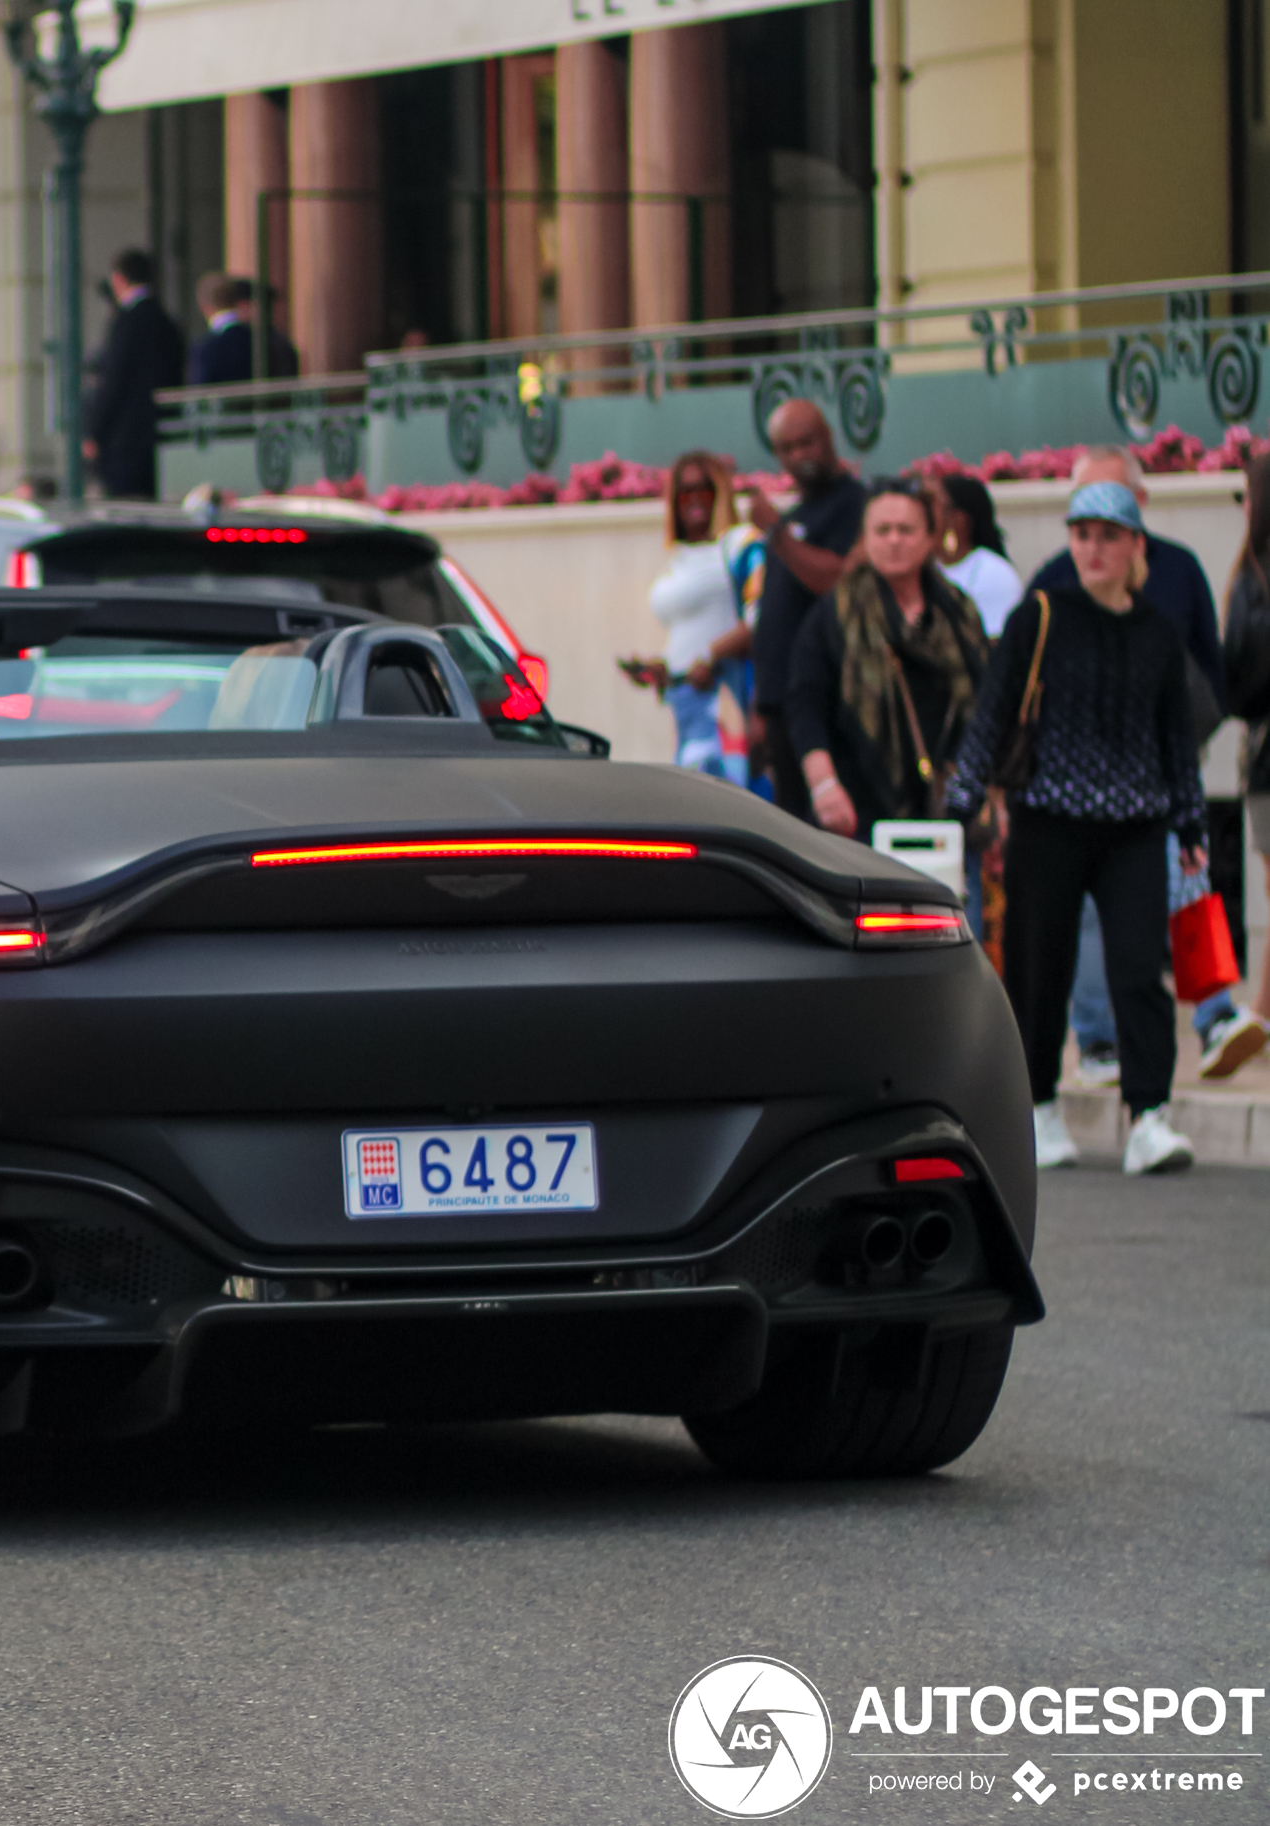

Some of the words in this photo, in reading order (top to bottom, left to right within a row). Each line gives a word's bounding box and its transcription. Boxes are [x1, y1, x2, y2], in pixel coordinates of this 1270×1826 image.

[420, 1134, 576, 1194] 6487
[368, 1186, 392, 1205] MC
[504, 1194, 519, 1204] DE
[523, 1193, 570, 1204] MONACO
